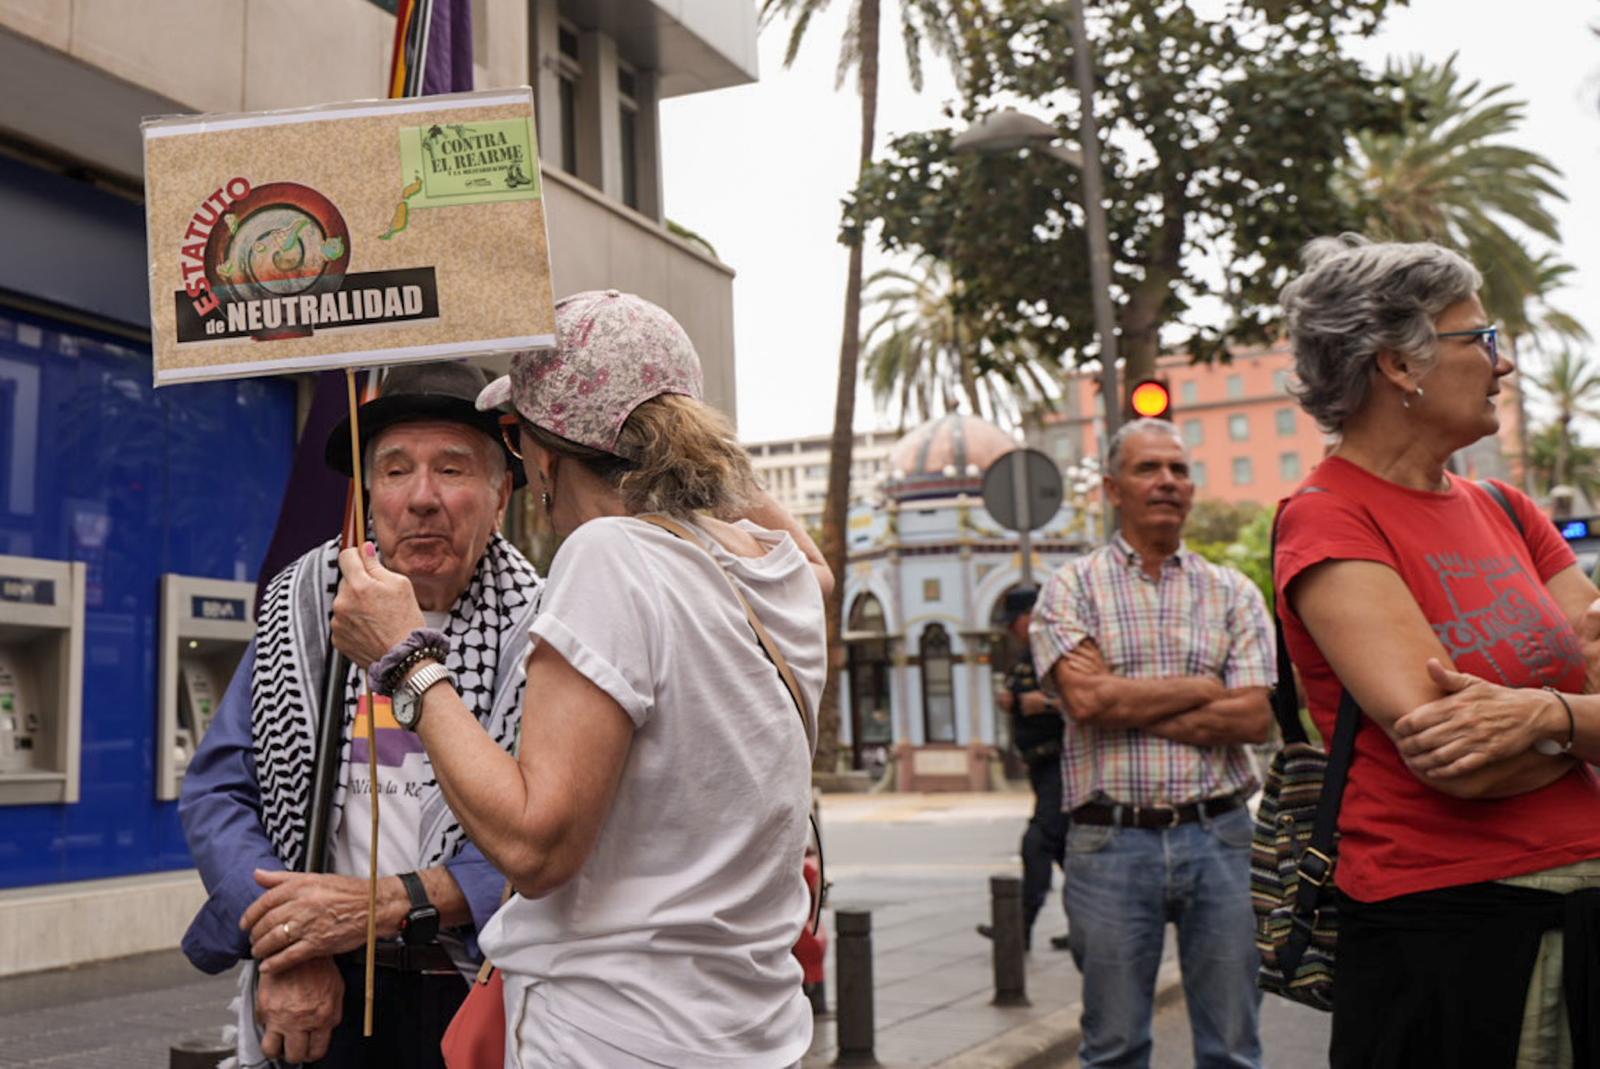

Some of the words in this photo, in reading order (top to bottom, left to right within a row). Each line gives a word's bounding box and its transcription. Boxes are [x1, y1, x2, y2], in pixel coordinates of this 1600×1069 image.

[441, 131, 508, 155] CONTRA
[431, 158, 451, 173] EL
[454, 145, 524, 170] REARME
[181, 177, 252, 317] ESTATUTO
[205, 318, 225, 334] de
[226, 285, 424, 332] NEUTRALIDAD
[352, 779, 382, 794] Via
[385, 780, 398, 794] la
